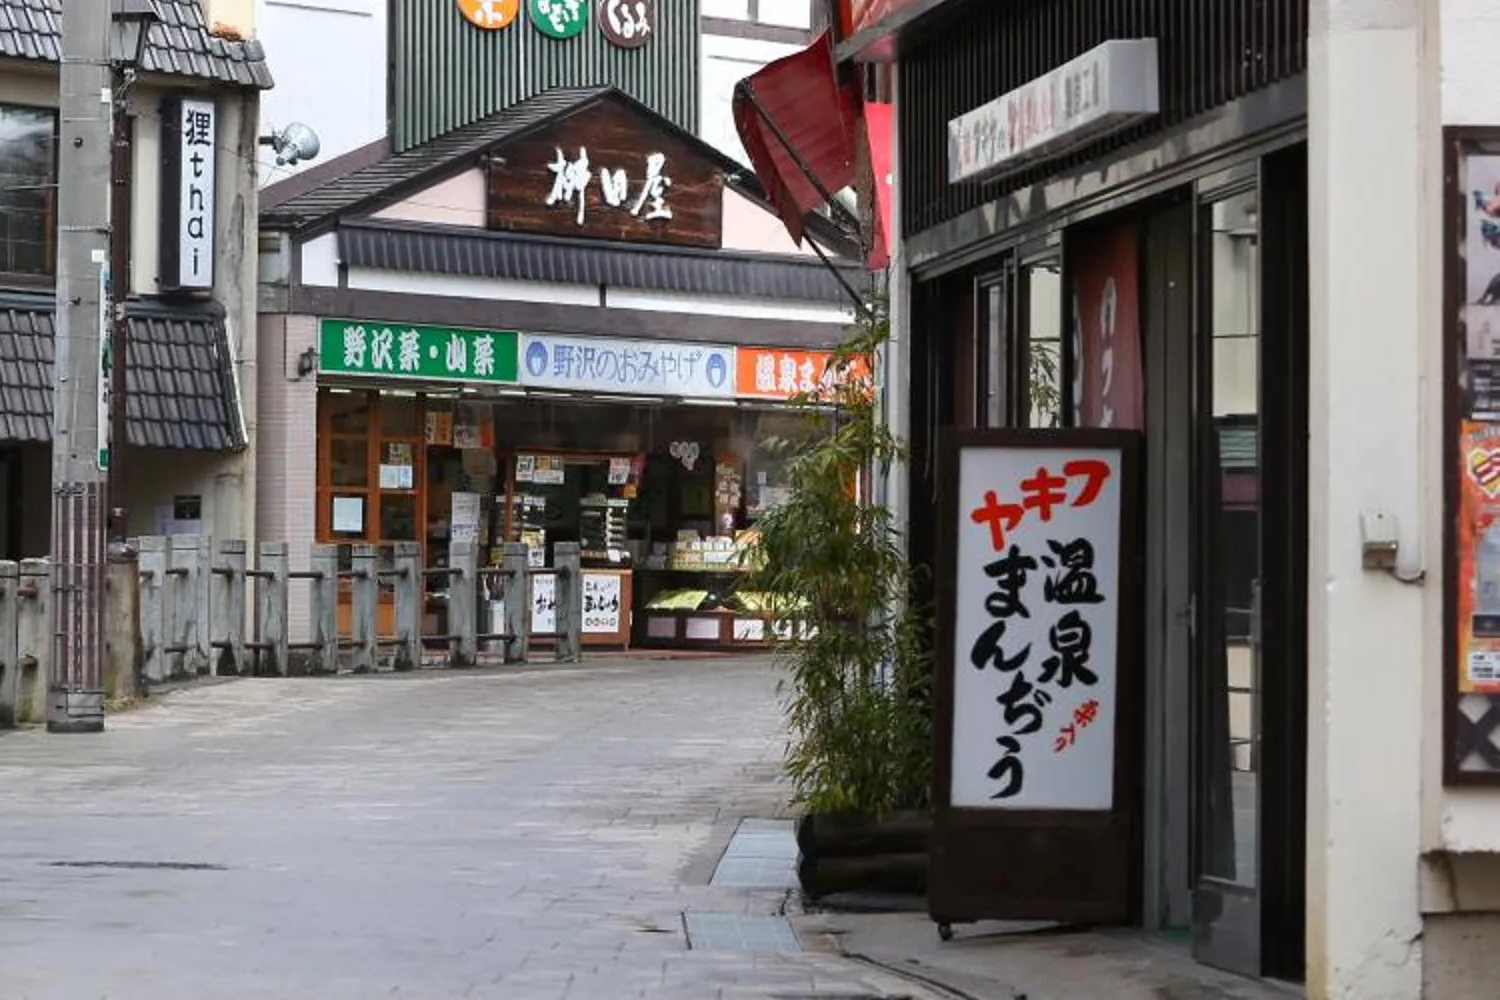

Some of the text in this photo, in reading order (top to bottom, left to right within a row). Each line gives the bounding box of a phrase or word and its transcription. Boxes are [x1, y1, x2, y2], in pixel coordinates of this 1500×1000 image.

[343, 325, 496, 377] 野沢菜・山菜
[553, 343, 703, 385] 野沢のおみやげ
[1037, 537, 1105, 689] 温泉
[970, 544, 1053, 800] まんぢう
